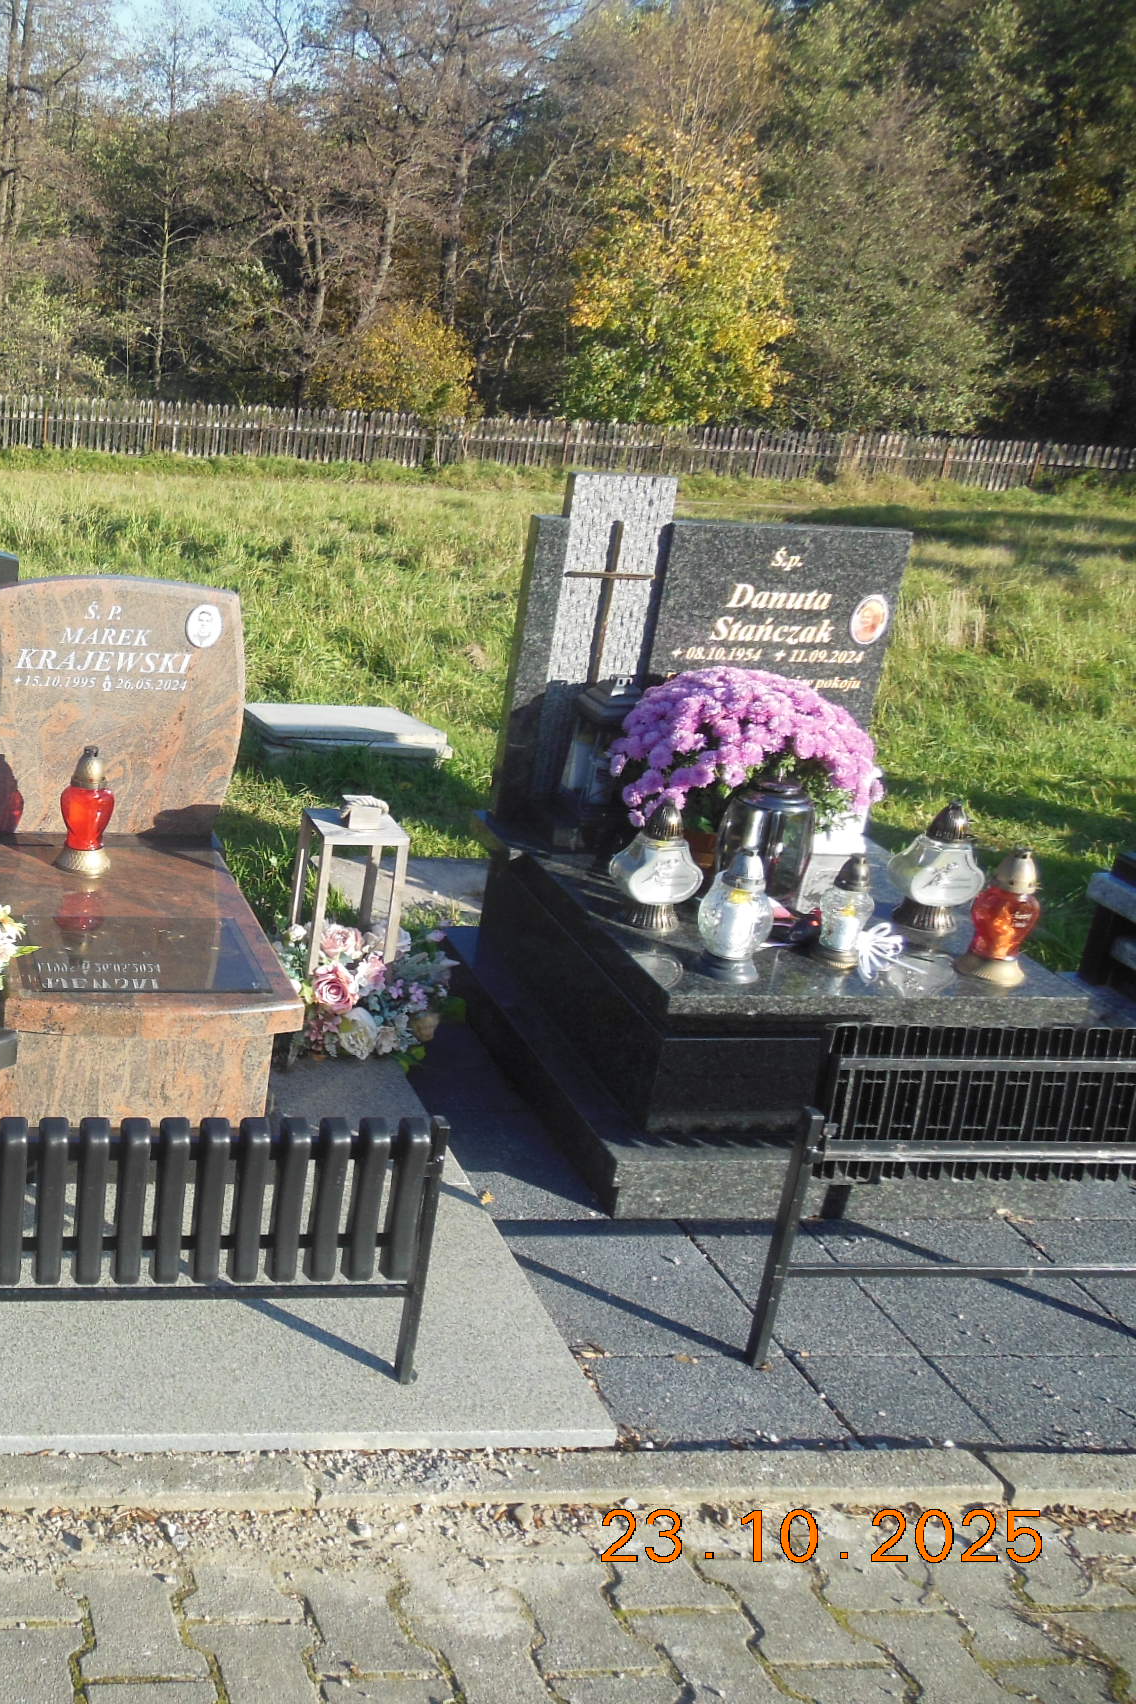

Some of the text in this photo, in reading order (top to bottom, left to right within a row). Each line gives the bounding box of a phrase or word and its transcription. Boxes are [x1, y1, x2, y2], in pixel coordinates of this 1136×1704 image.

[771, 547, 803, 571] Ś.p.
[726, 583, 832, 610] Danuta
[59, 627, 152, 646] MAREK
[710, 615, 836, 645] Stańczak
[15, 648, 193, 674] KRAJEWSKI
[686, 647, 865, 664] 08.10.1954 11.09.2024
[115, 678, 188, 691] 26.05.2024
[815, 676, 861, 692] pokoju
